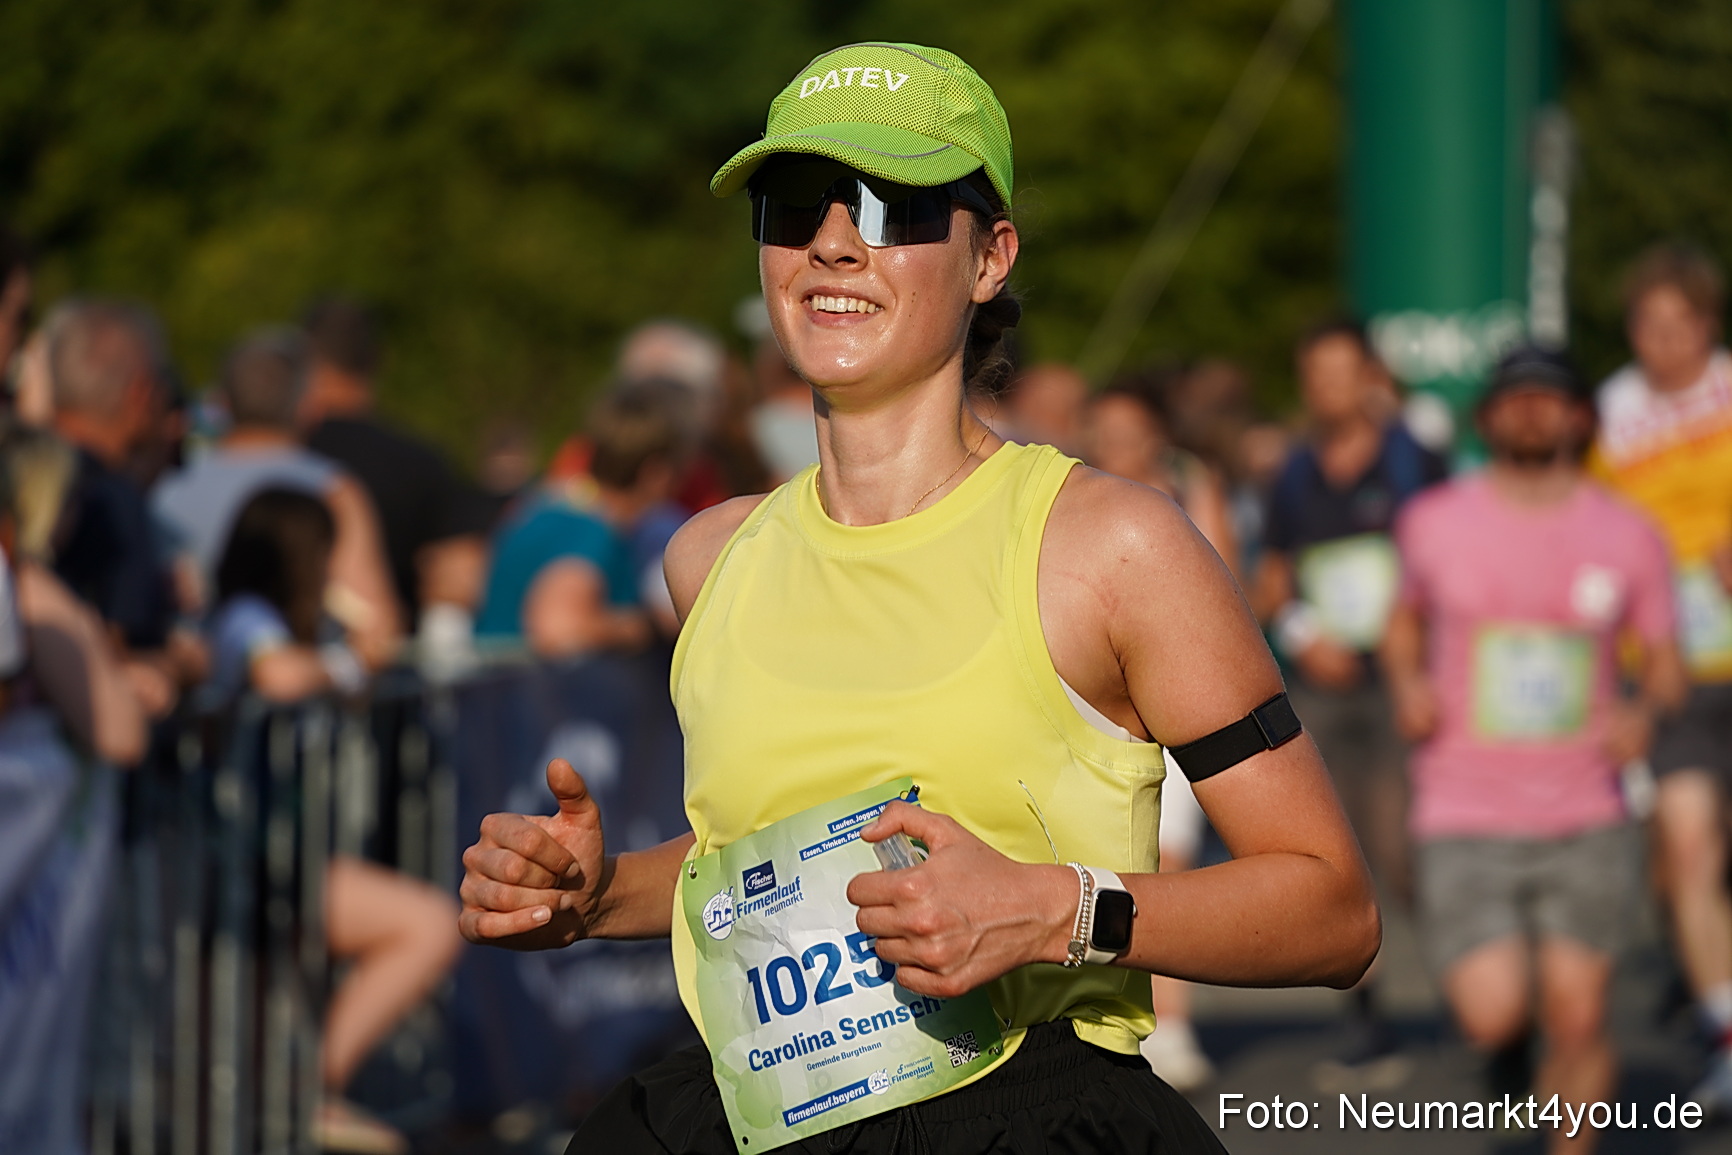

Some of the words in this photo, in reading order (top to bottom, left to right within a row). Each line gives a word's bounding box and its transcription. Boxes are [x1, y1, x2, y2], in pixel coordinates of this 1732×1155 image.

[799, 67, 910, 99] DATEV
[831, 817, 856, 832] Laufen,
[855, 809, 880, 823] Joggen,
[802, 845, 823, 859] Essen,
[821, 836, 848, 852] Trinken,
[847, 829, 861, 842] Feie
[736, 875, 801, 919] Firmenlauf
[763, 891, 804, 917] neumarkt
[748, 1029, 837, 1072] Carolina
[838, 994, 947, 1041] Semsch
[806, 1055, 841, 1072] Gemeinde
[840, 1041, 883, 1061] Burgthann
[891, 1061, 934, 1085] Firmenlauf
[787, 1085, 866, 1124] firmenlauf.bayern
